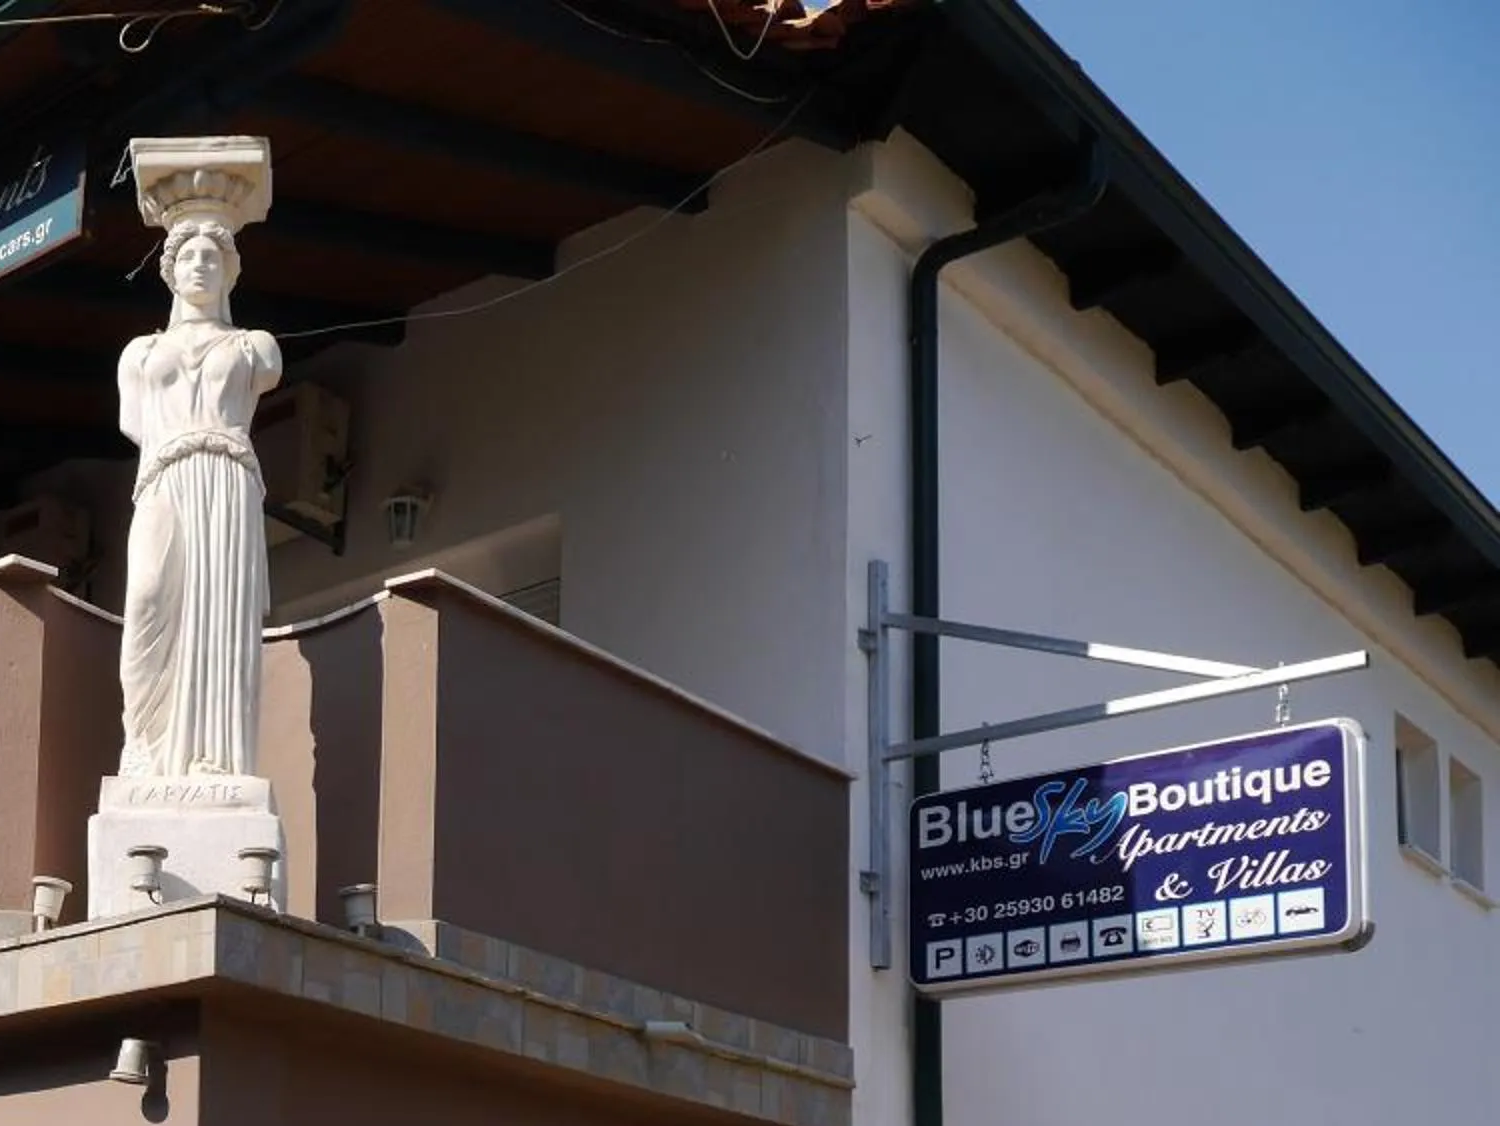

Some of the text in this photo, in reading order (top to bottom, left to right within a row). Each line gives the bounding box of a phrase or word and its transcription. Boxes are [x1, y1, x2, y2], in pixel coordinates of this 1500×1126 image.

[1129, 759, 1331, 817] Boutique
[1090, 807, 1331, 873] Apartments
[920, 852, 1030, 881] www.kbs.gr
[1155, 849, 1332, 901] & Villas
[950, 885, 1124, 925] +30 25930 61482
[1197, 909, 1216, 918] TV
